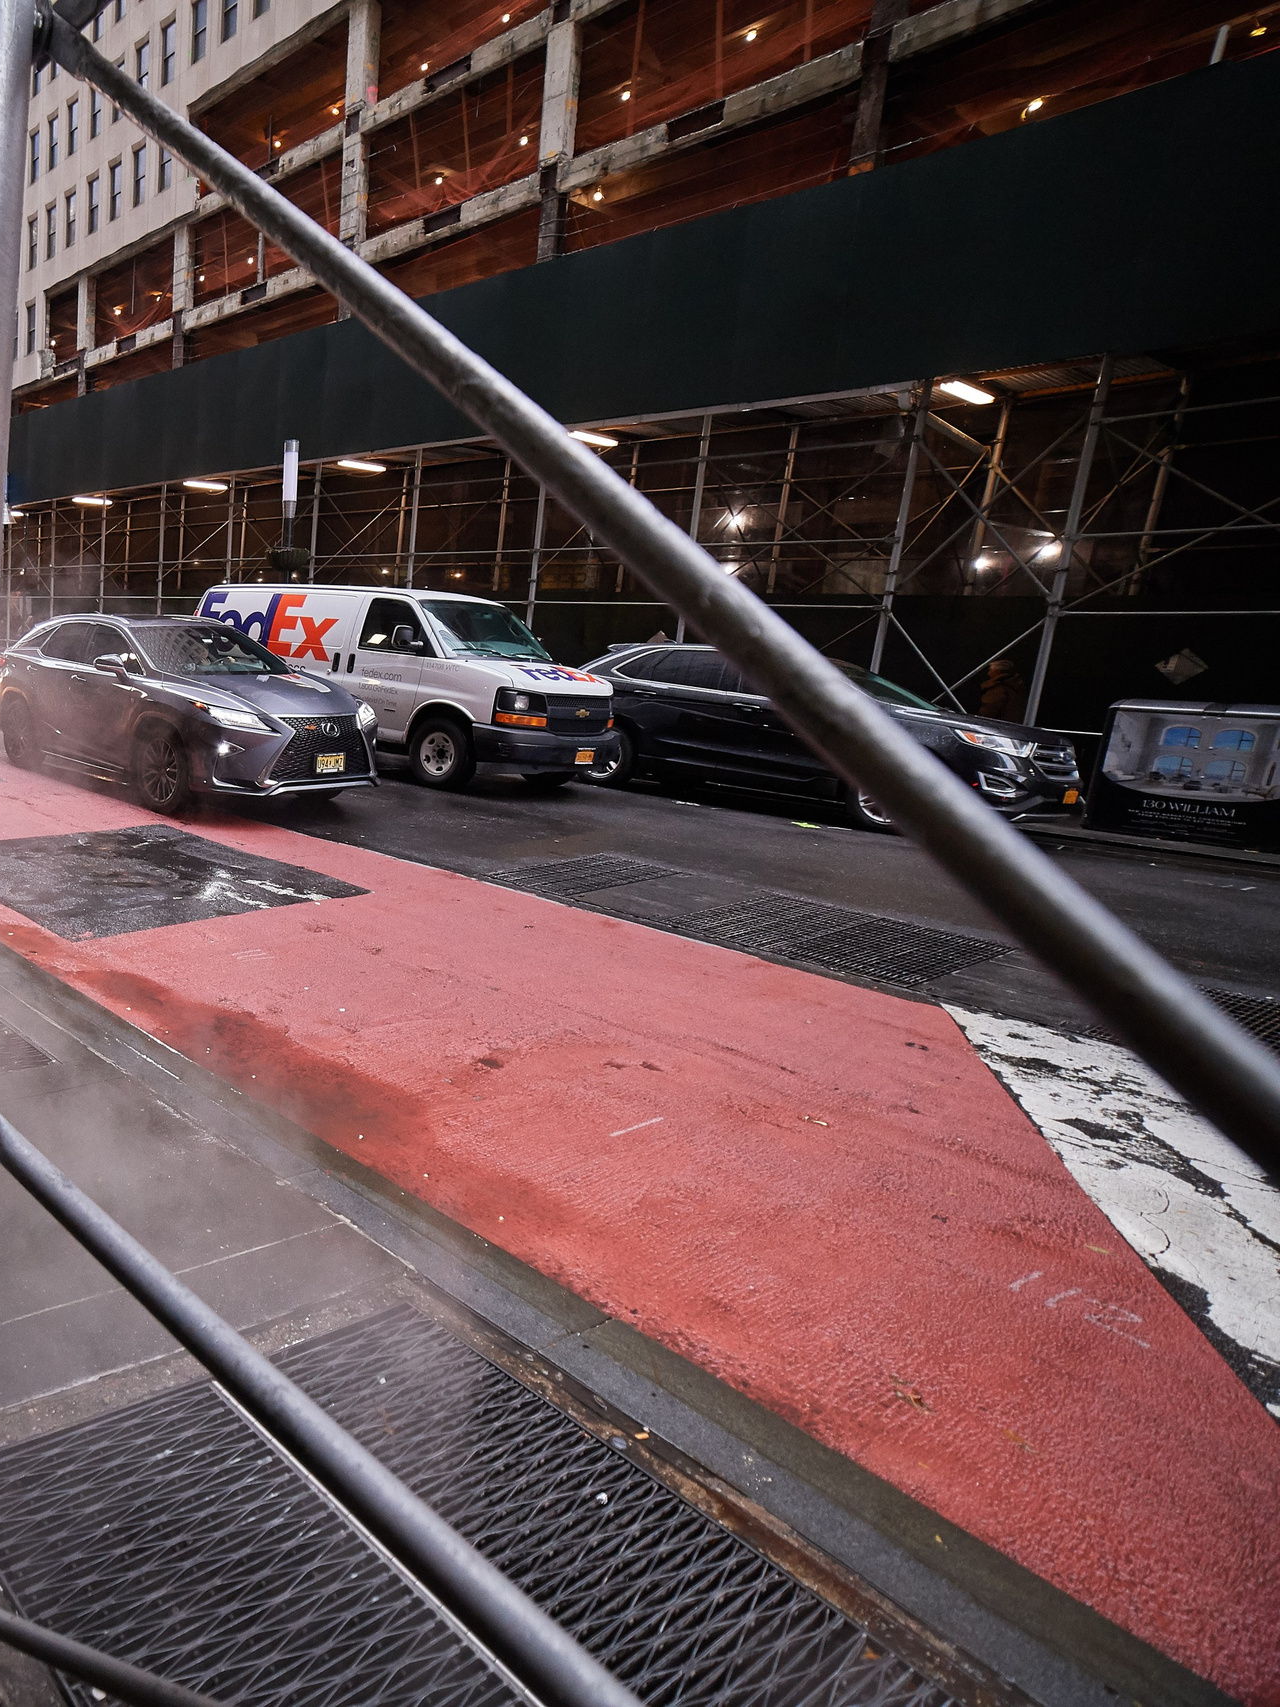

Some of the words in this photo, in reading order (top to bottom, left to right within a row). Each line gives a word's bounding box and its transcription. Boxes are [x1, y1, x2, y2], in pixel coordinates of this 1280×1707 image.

[361, 666, 403, 682] fedex.com
[1142, 799, 1167, 810] 130
[1169, 801, 1236, 818] WILLIAM
